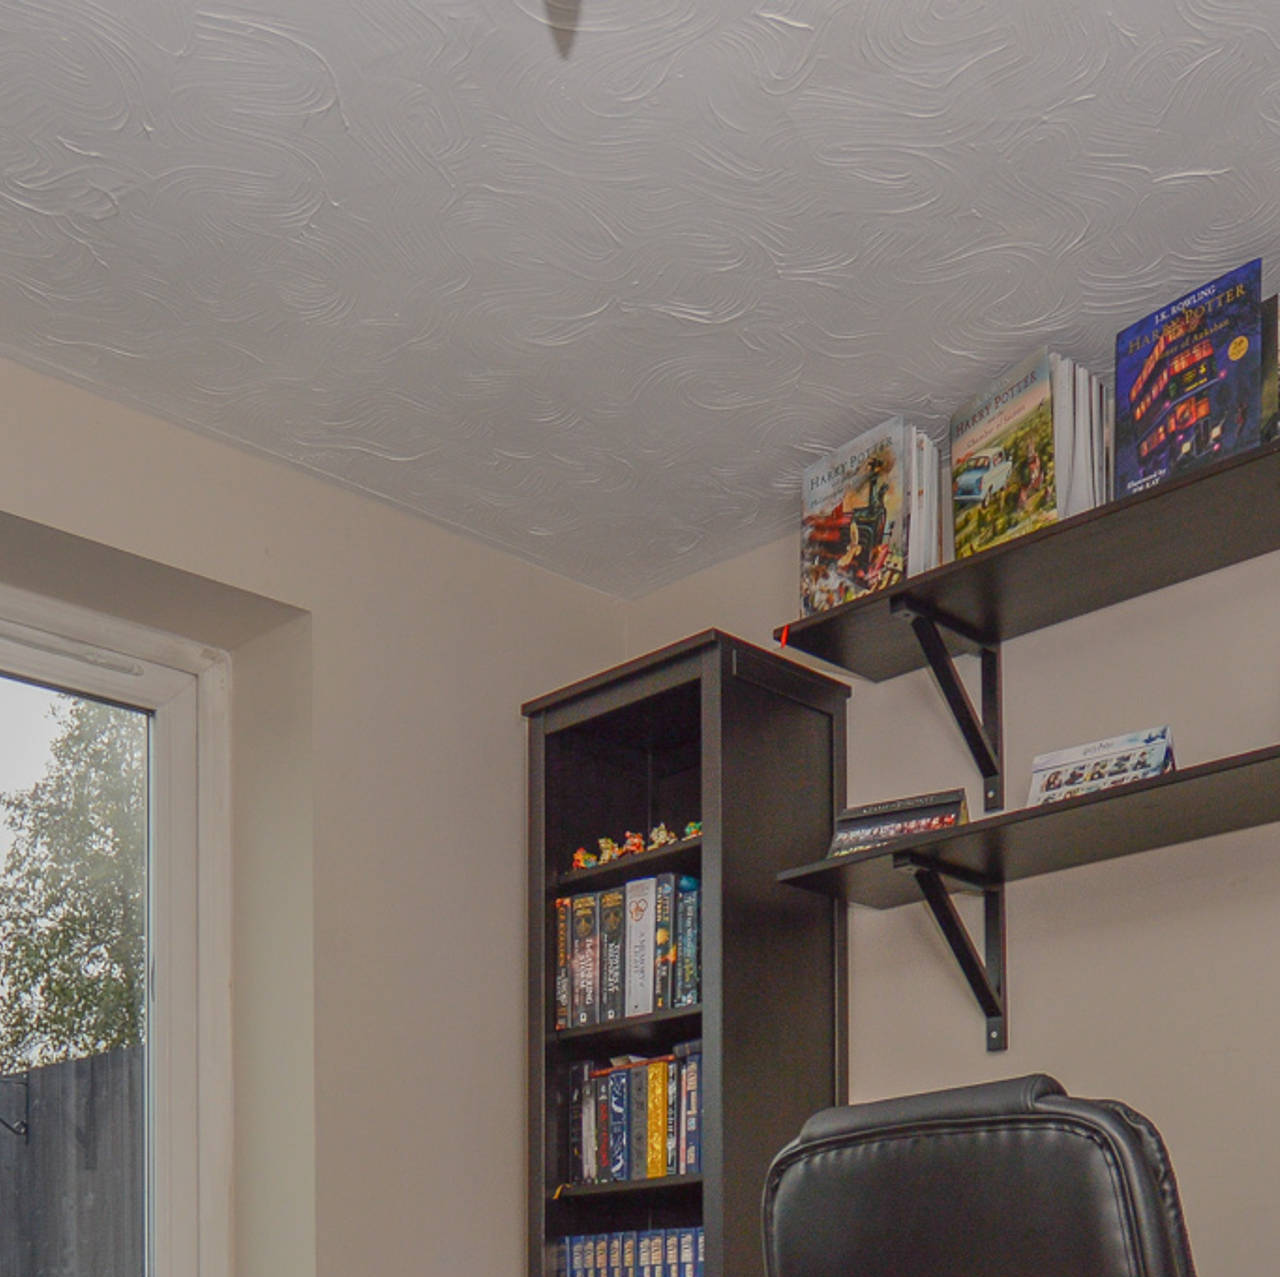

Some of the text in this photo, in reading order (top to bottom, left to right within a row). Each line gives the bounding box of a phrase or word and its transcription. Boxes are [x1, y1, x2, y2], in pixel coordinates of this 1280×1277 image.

[1128, 283, 1246, 355] HARRY POTTER
[1171, 285, 1216, 313] ROWLING
[956, 371, 1037, 434] HARRY POTTER
[810, 462, 846, 491] HARRY
